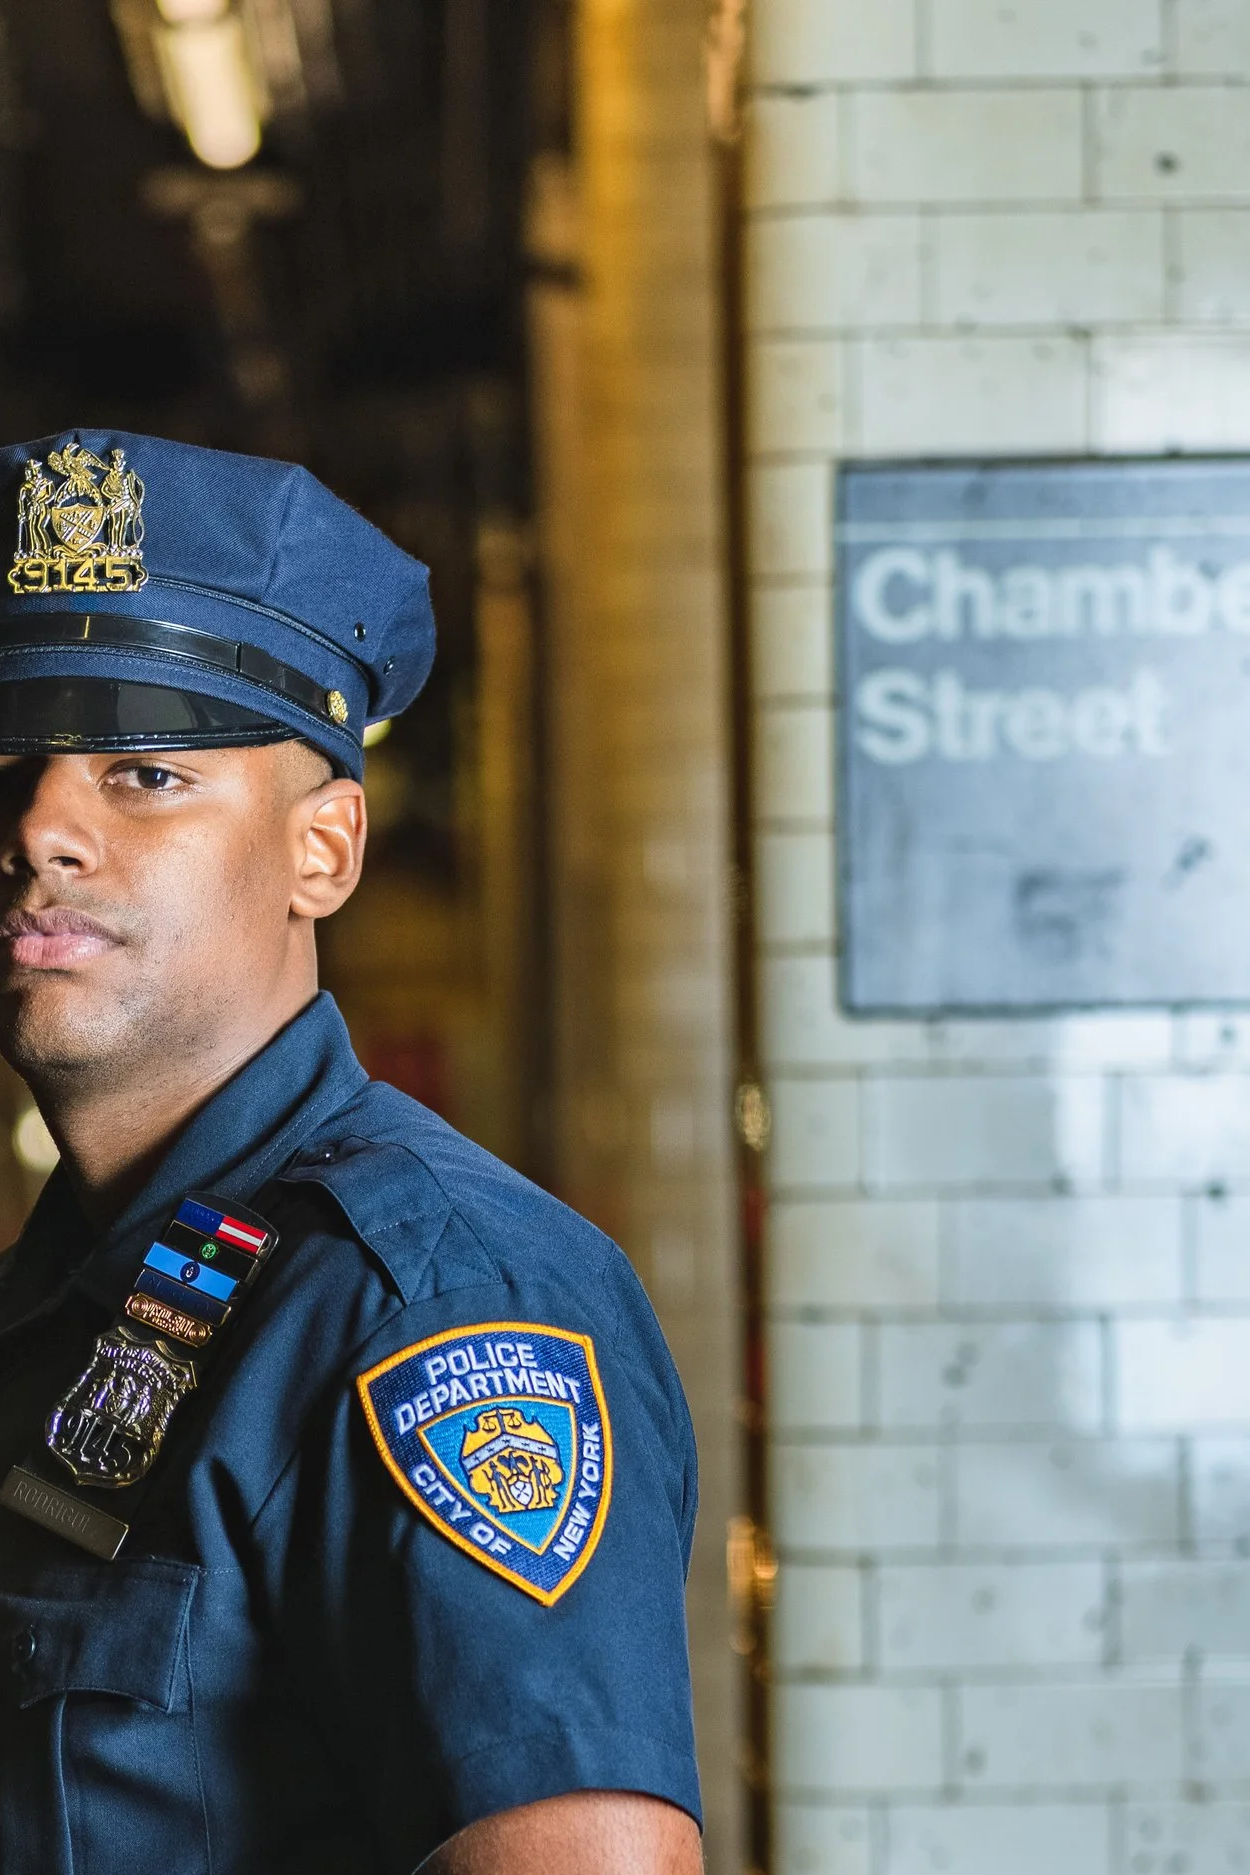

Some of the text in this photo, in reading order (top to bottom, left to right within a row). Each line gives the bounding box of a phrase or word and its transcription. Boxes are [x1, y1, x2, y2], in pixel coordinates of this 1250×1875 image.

[24, 557, 133, 591] 9145
[855, 668, 1170, 765] Street
[425, 1341, 538, 1386] POLICE
[393, 1368, 581, 1436] DEPARTMENT
[414, 1422, 601, 1561] CITY OF NEW YORK
